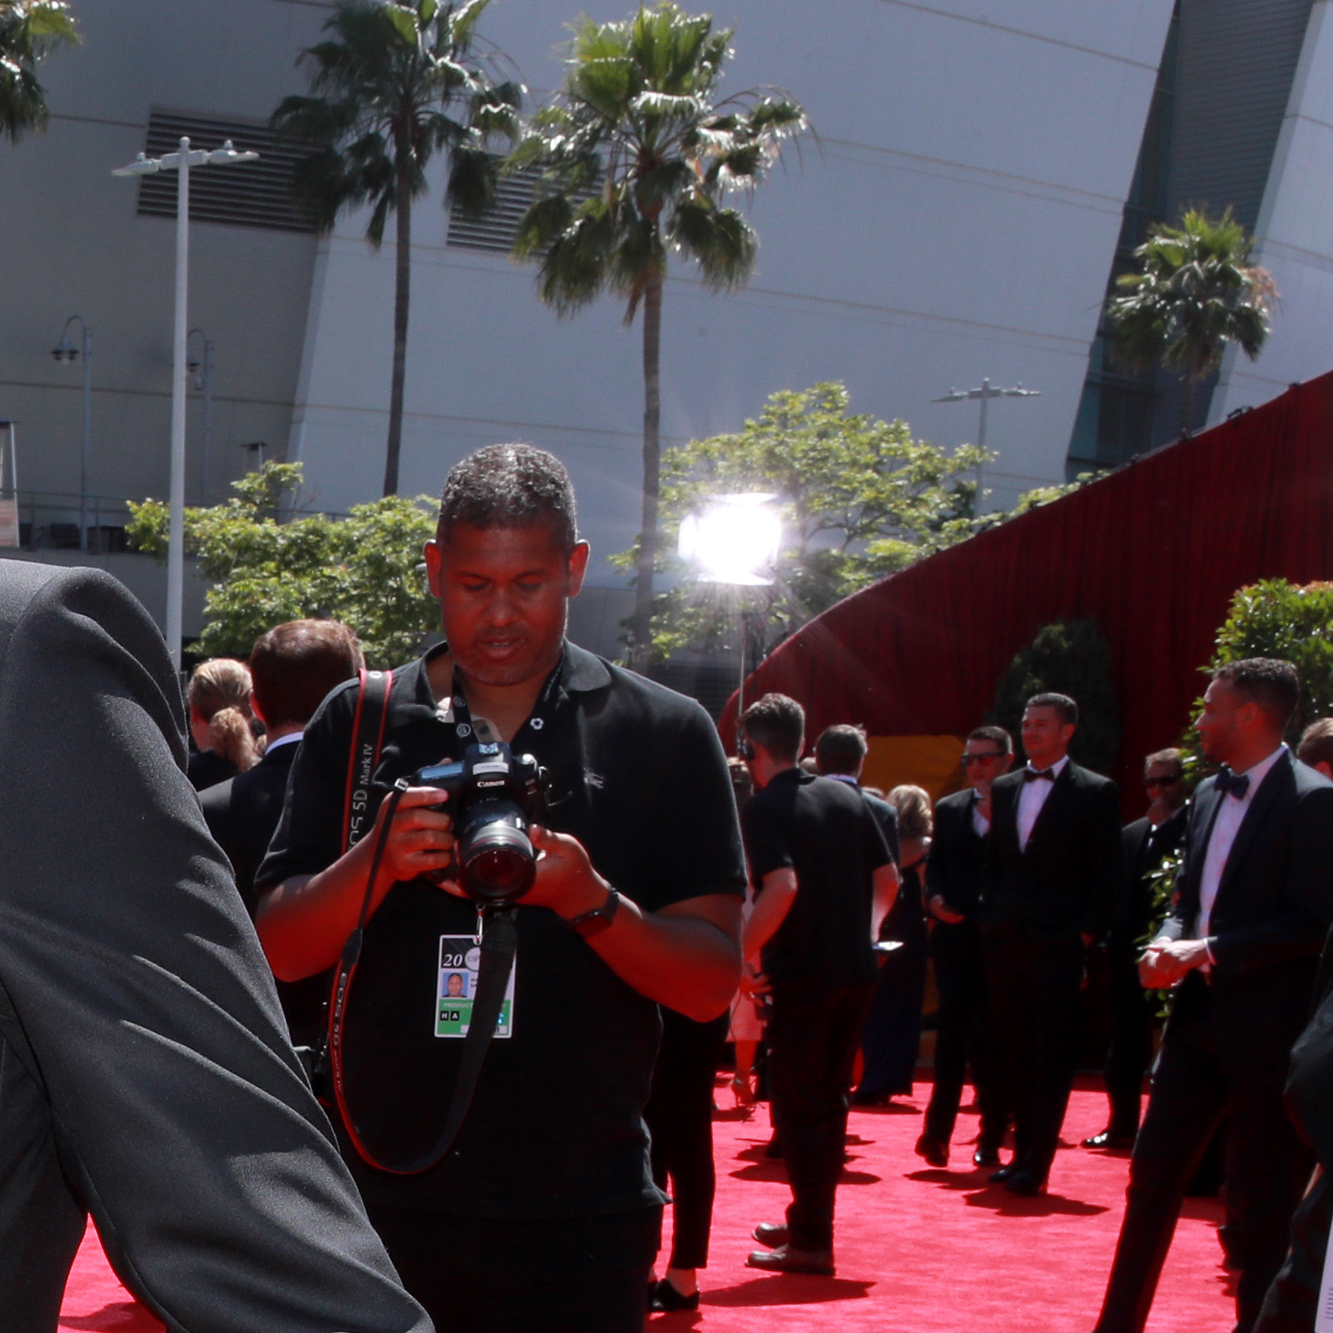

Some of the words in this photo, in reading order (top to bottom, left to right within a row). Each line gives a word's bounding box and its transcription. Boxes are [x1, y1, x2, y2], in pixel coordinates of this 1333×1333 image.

[364, 744, 373, 755] IV
[359, 757, 372, 786] Mark
[477, 780, 505, 788] Canon
[352, 789, 368, 811] 5D
[443, 953, 463, 967] 20
